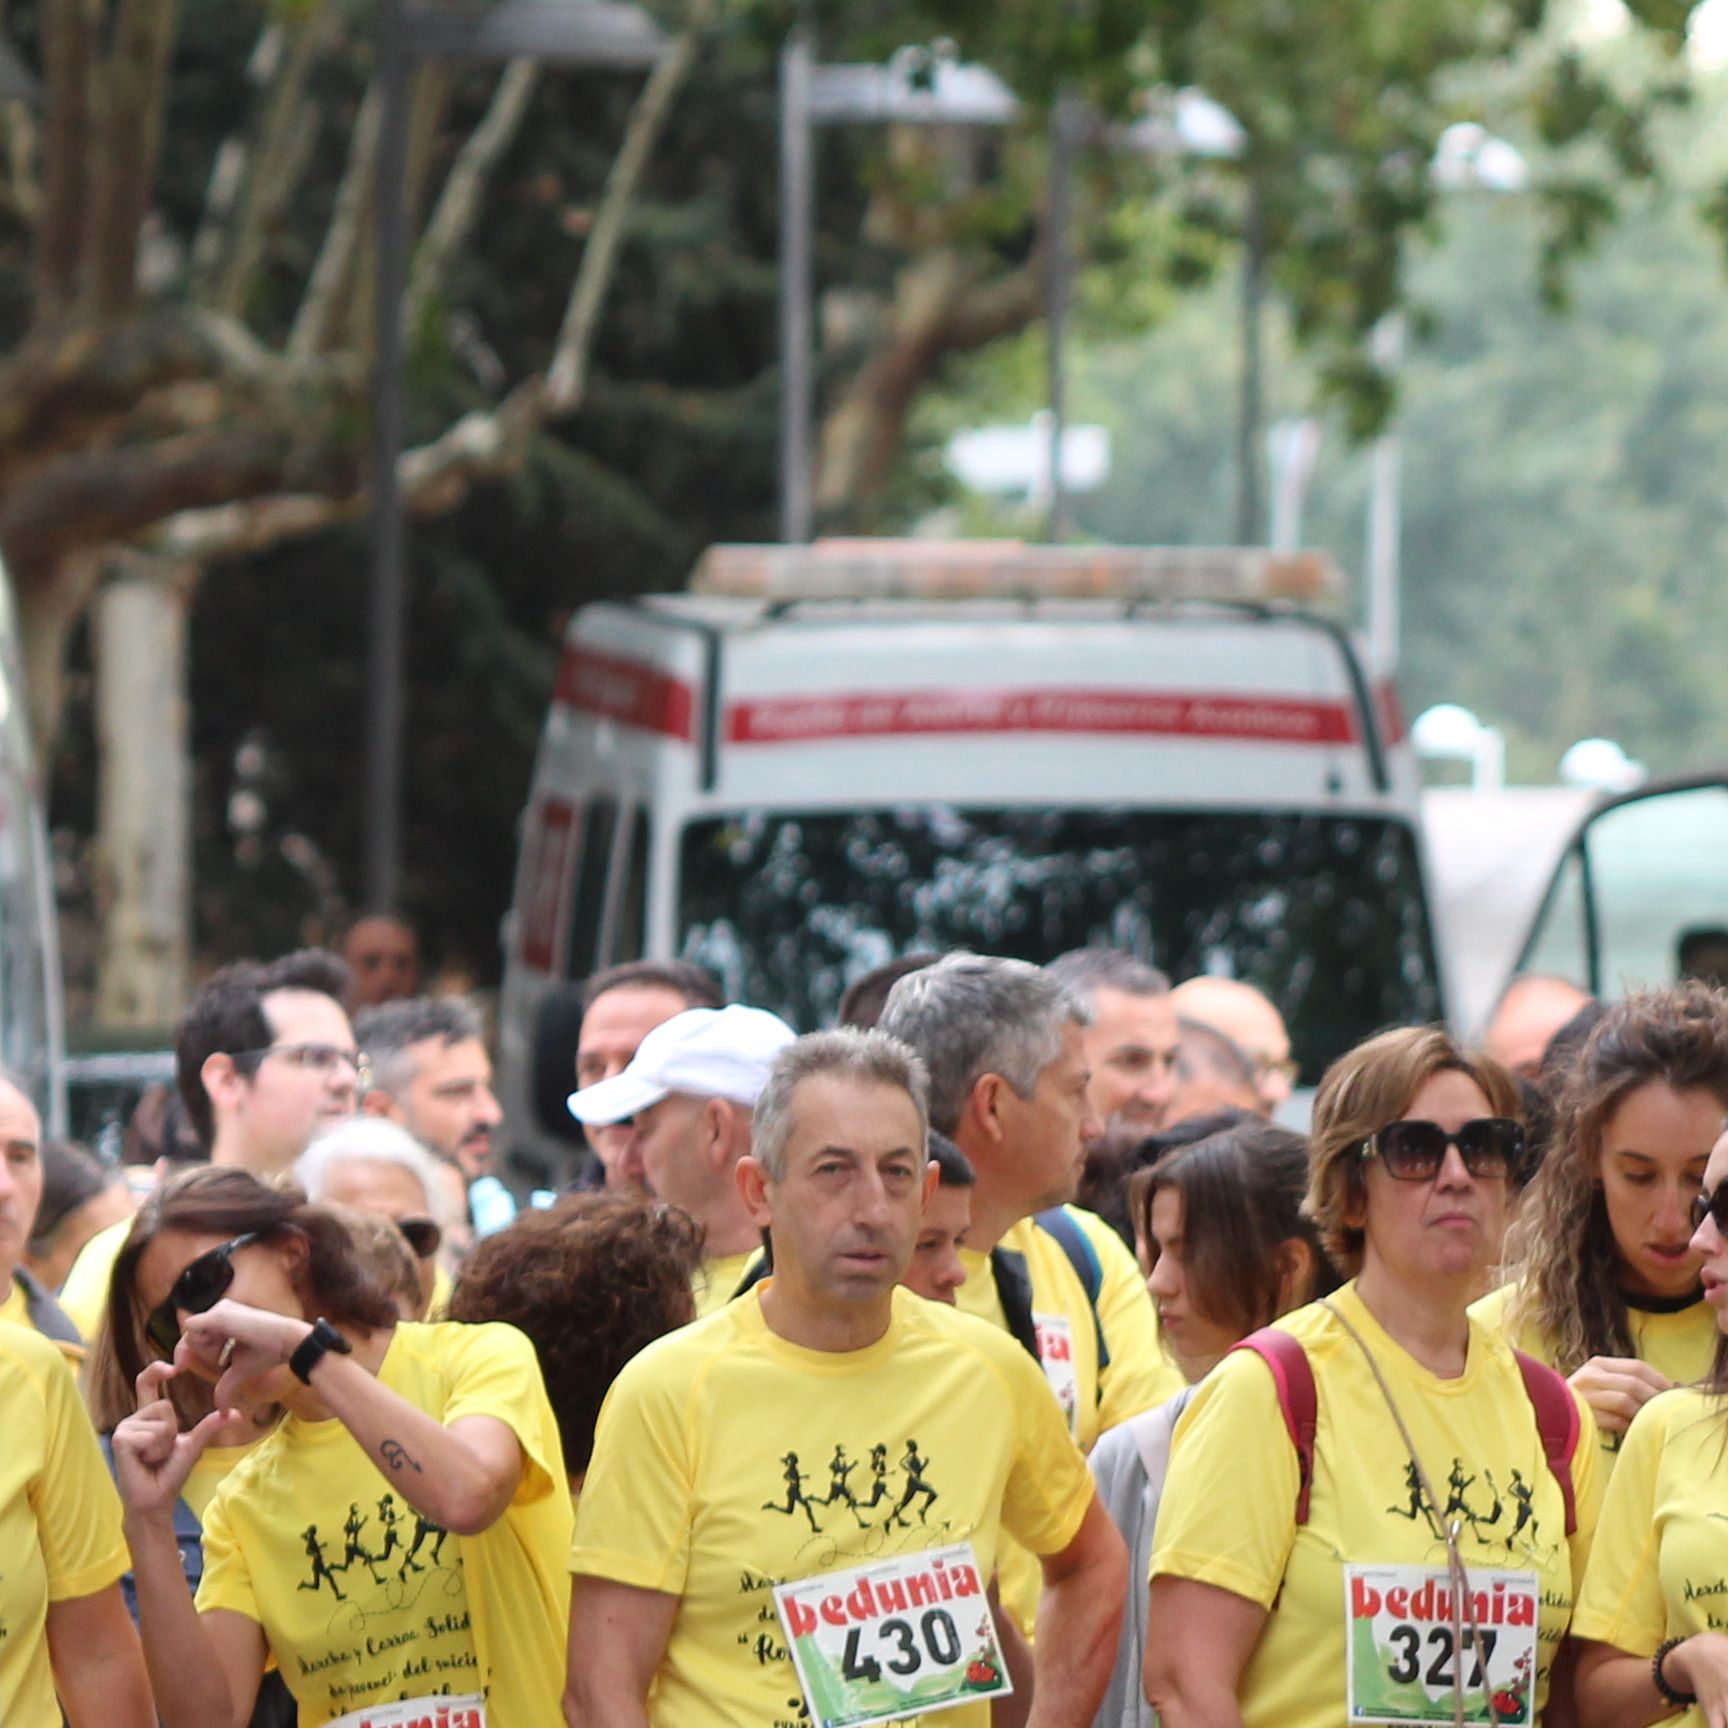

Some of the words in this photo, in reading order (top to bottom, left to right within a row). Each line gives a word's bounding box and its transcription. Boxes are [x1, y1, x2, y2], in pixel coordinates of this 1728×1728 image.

[782, 1559, 981, 1639] bedunia
[1351, 1576, 1535, 1627] bedunia
[402, 1656, 432, 1677] del
[841, 1608, 962, 1684] 430
[1387, 1624, 1498, 1688] 327
